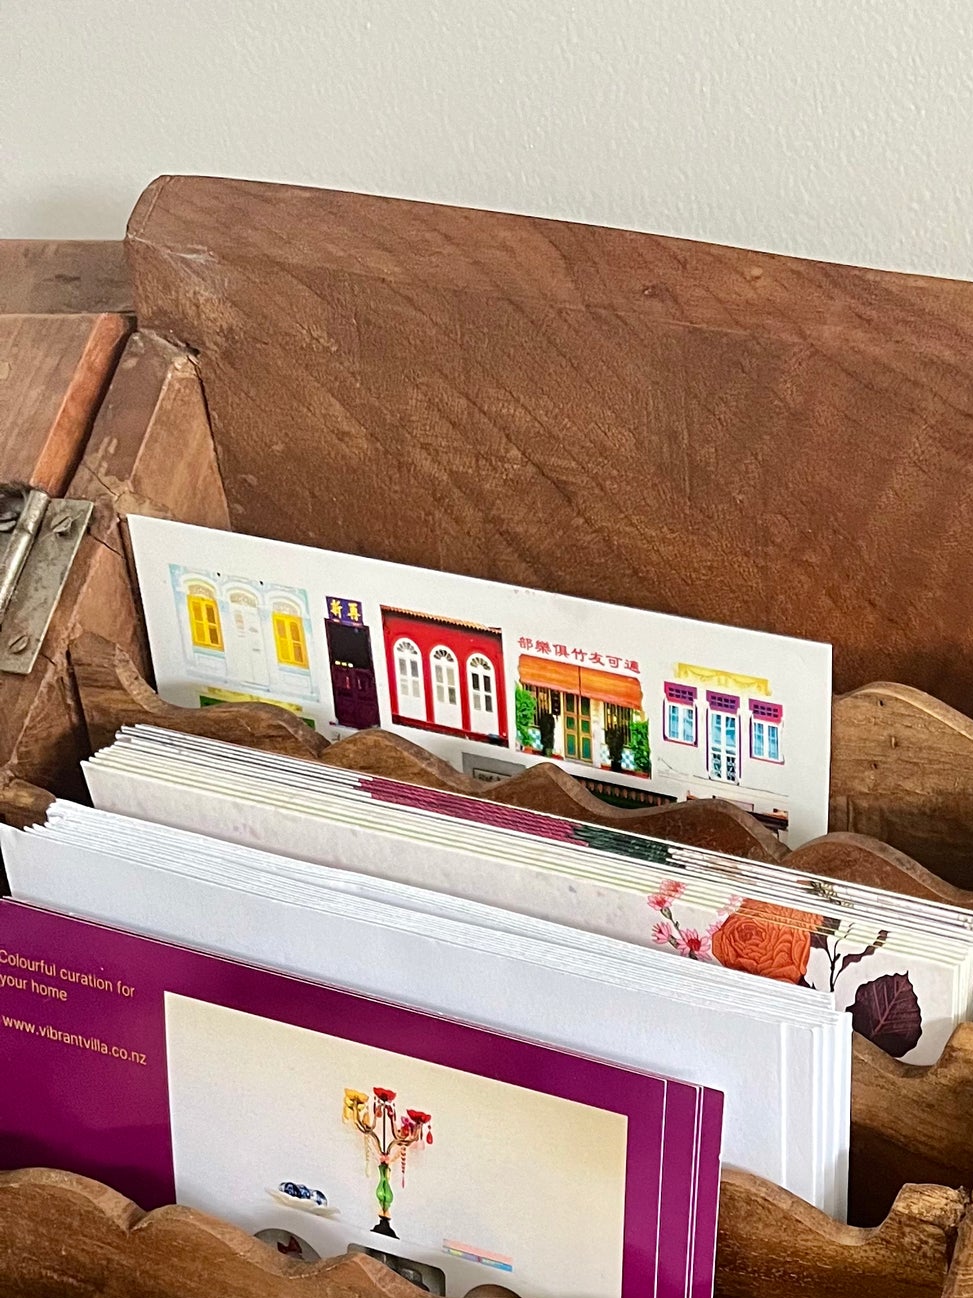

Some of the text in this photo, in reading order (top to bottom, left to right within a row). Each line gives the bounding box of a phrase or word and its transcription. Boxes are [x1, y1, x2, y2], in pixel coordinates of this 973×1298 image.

[0, 949, 135, 997] Colourful curation for
[0, 973, 68, 1001] your home
[2, 1014, 147, 1065] www.vibrantvilla.co.nz
